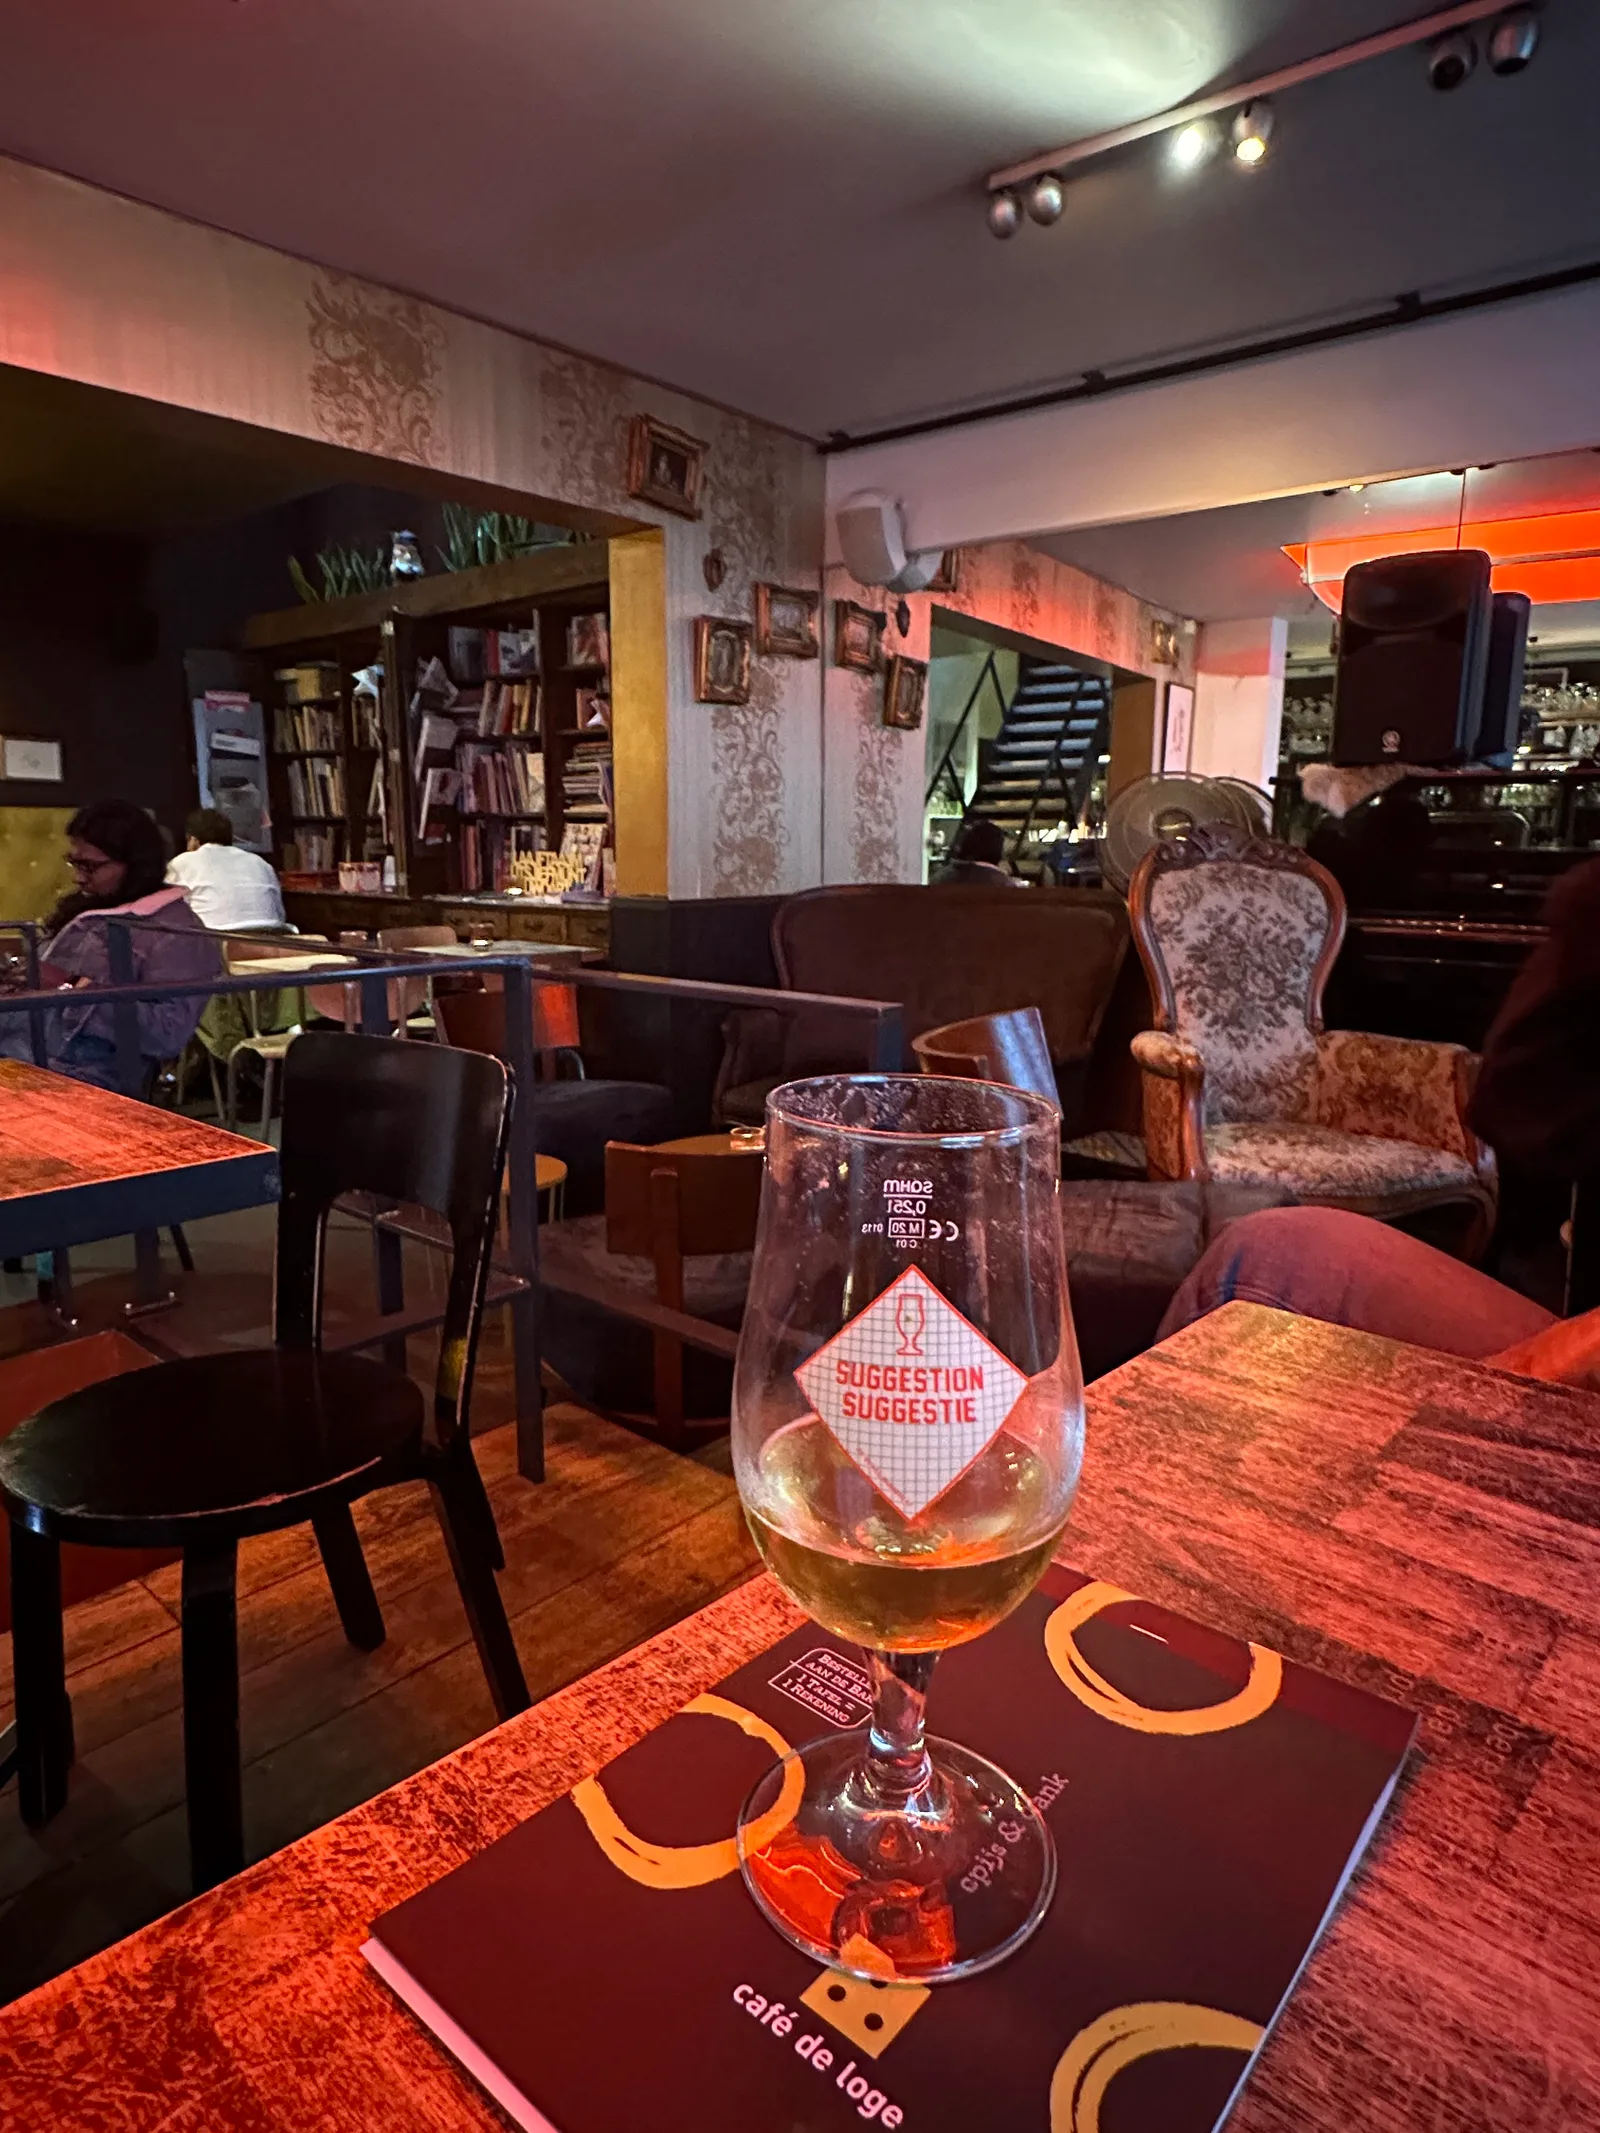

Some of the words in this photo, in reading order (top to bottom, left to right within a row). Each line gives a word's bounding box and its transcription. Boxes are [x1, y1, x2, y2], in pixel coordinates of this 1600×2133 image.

[836, 1359, 984, 1394] SUGGESTION
[841, 1391, 977, 1424] SUGGESTIE
[998, 1820, 1027, 1843] &
[733, 1983, 799, 2038] café
[794, 2034, 834, 2071] de
[836, 2061, 904, 2130] loge
